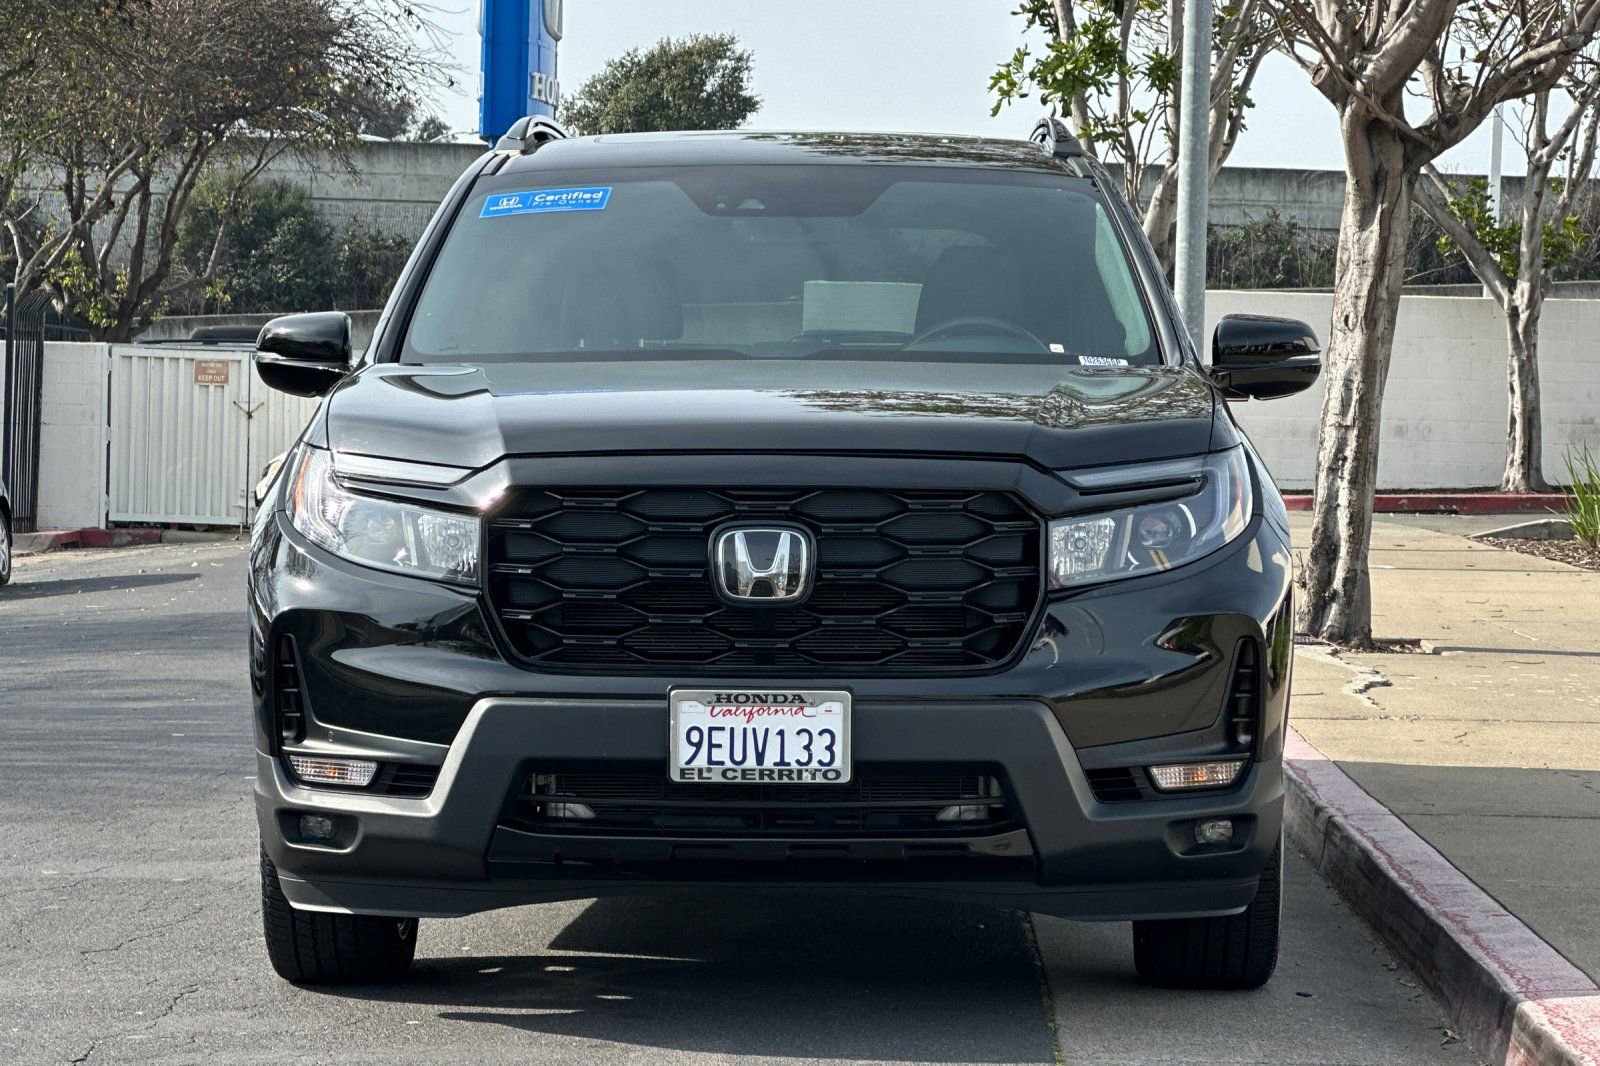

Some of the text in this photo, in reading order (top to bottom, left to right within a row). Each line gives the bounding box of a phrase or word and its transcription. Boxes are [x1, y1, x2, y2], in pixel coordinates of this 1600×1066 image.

[534, 191, 603, 202] Certified
[533, 199, 600, 207] Pre-Owned
[714, 693, 807, 704] HONDA
[710, 706, 816, 724] California
[685, 725, 836, 767] 9EUV133
[679, 768, 842, 781] EL CERRITO
